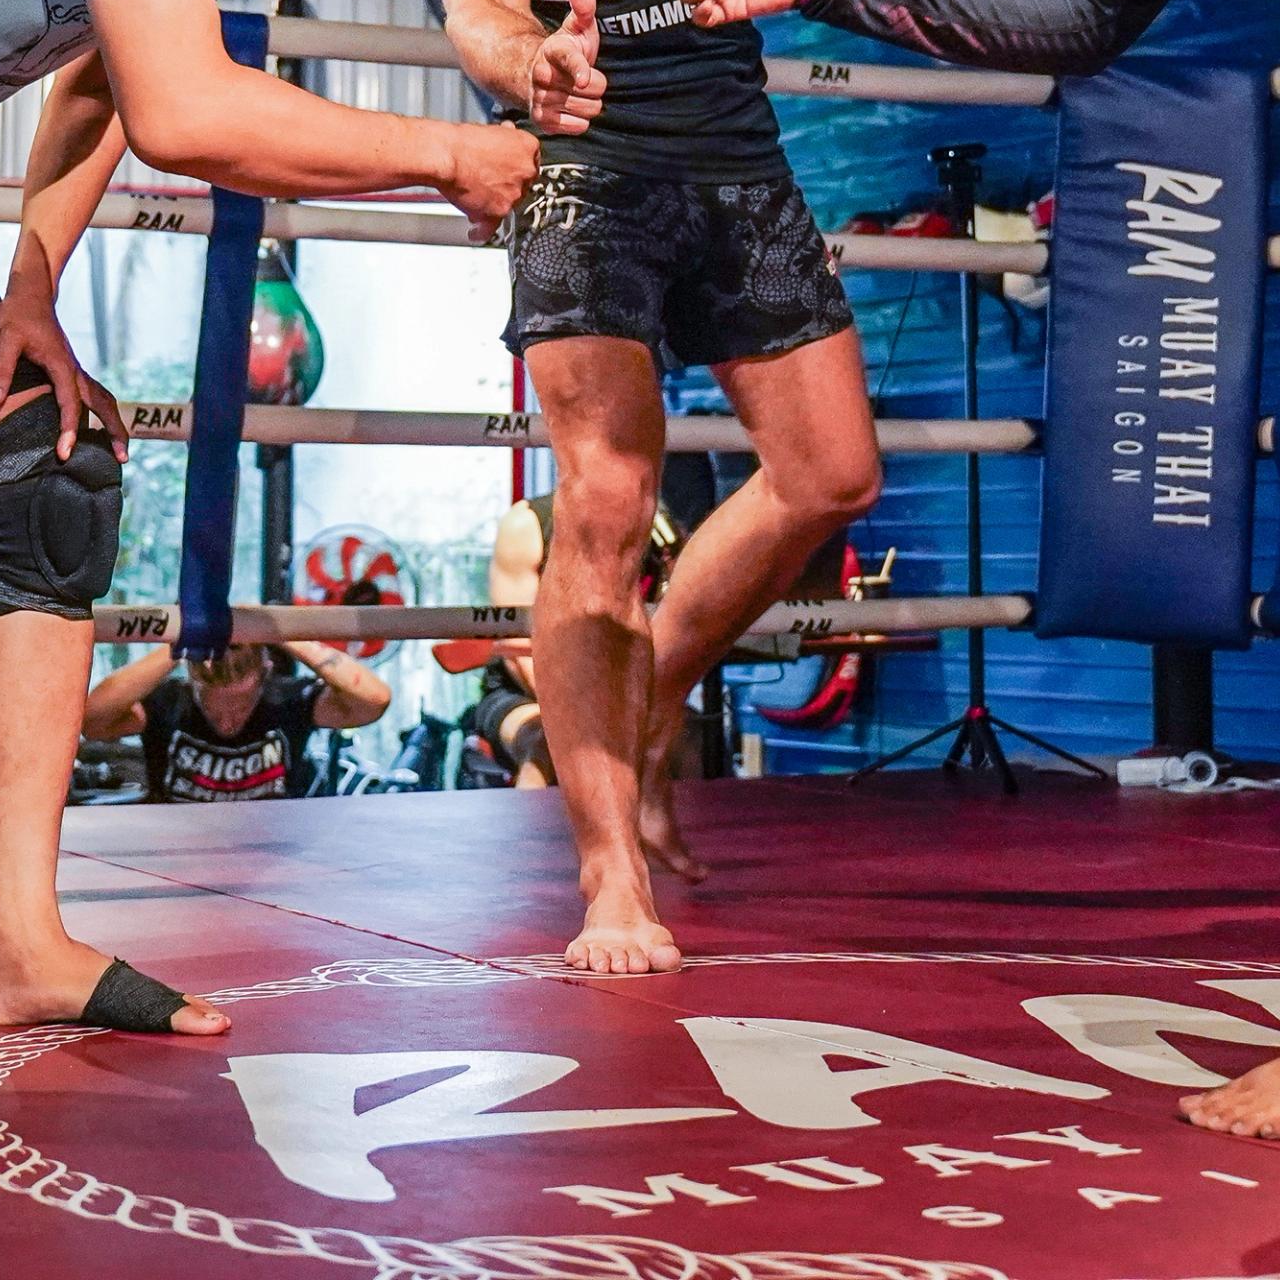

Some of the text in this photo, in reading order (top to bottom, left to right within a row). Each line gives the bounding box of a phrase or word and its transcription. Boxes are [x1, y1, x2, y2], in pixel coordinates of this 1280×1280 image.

[1114, 162, 1223, 528] RAM MUAY THAI
[130, 407, 184, 430] RAM
[483, 415, 530, 438] RAM
[1112, 333, 1150, 484] SAIGON
[175, 738, 283, 783] SAIGON
[542, 1125, 1143, 1219] MUAY
